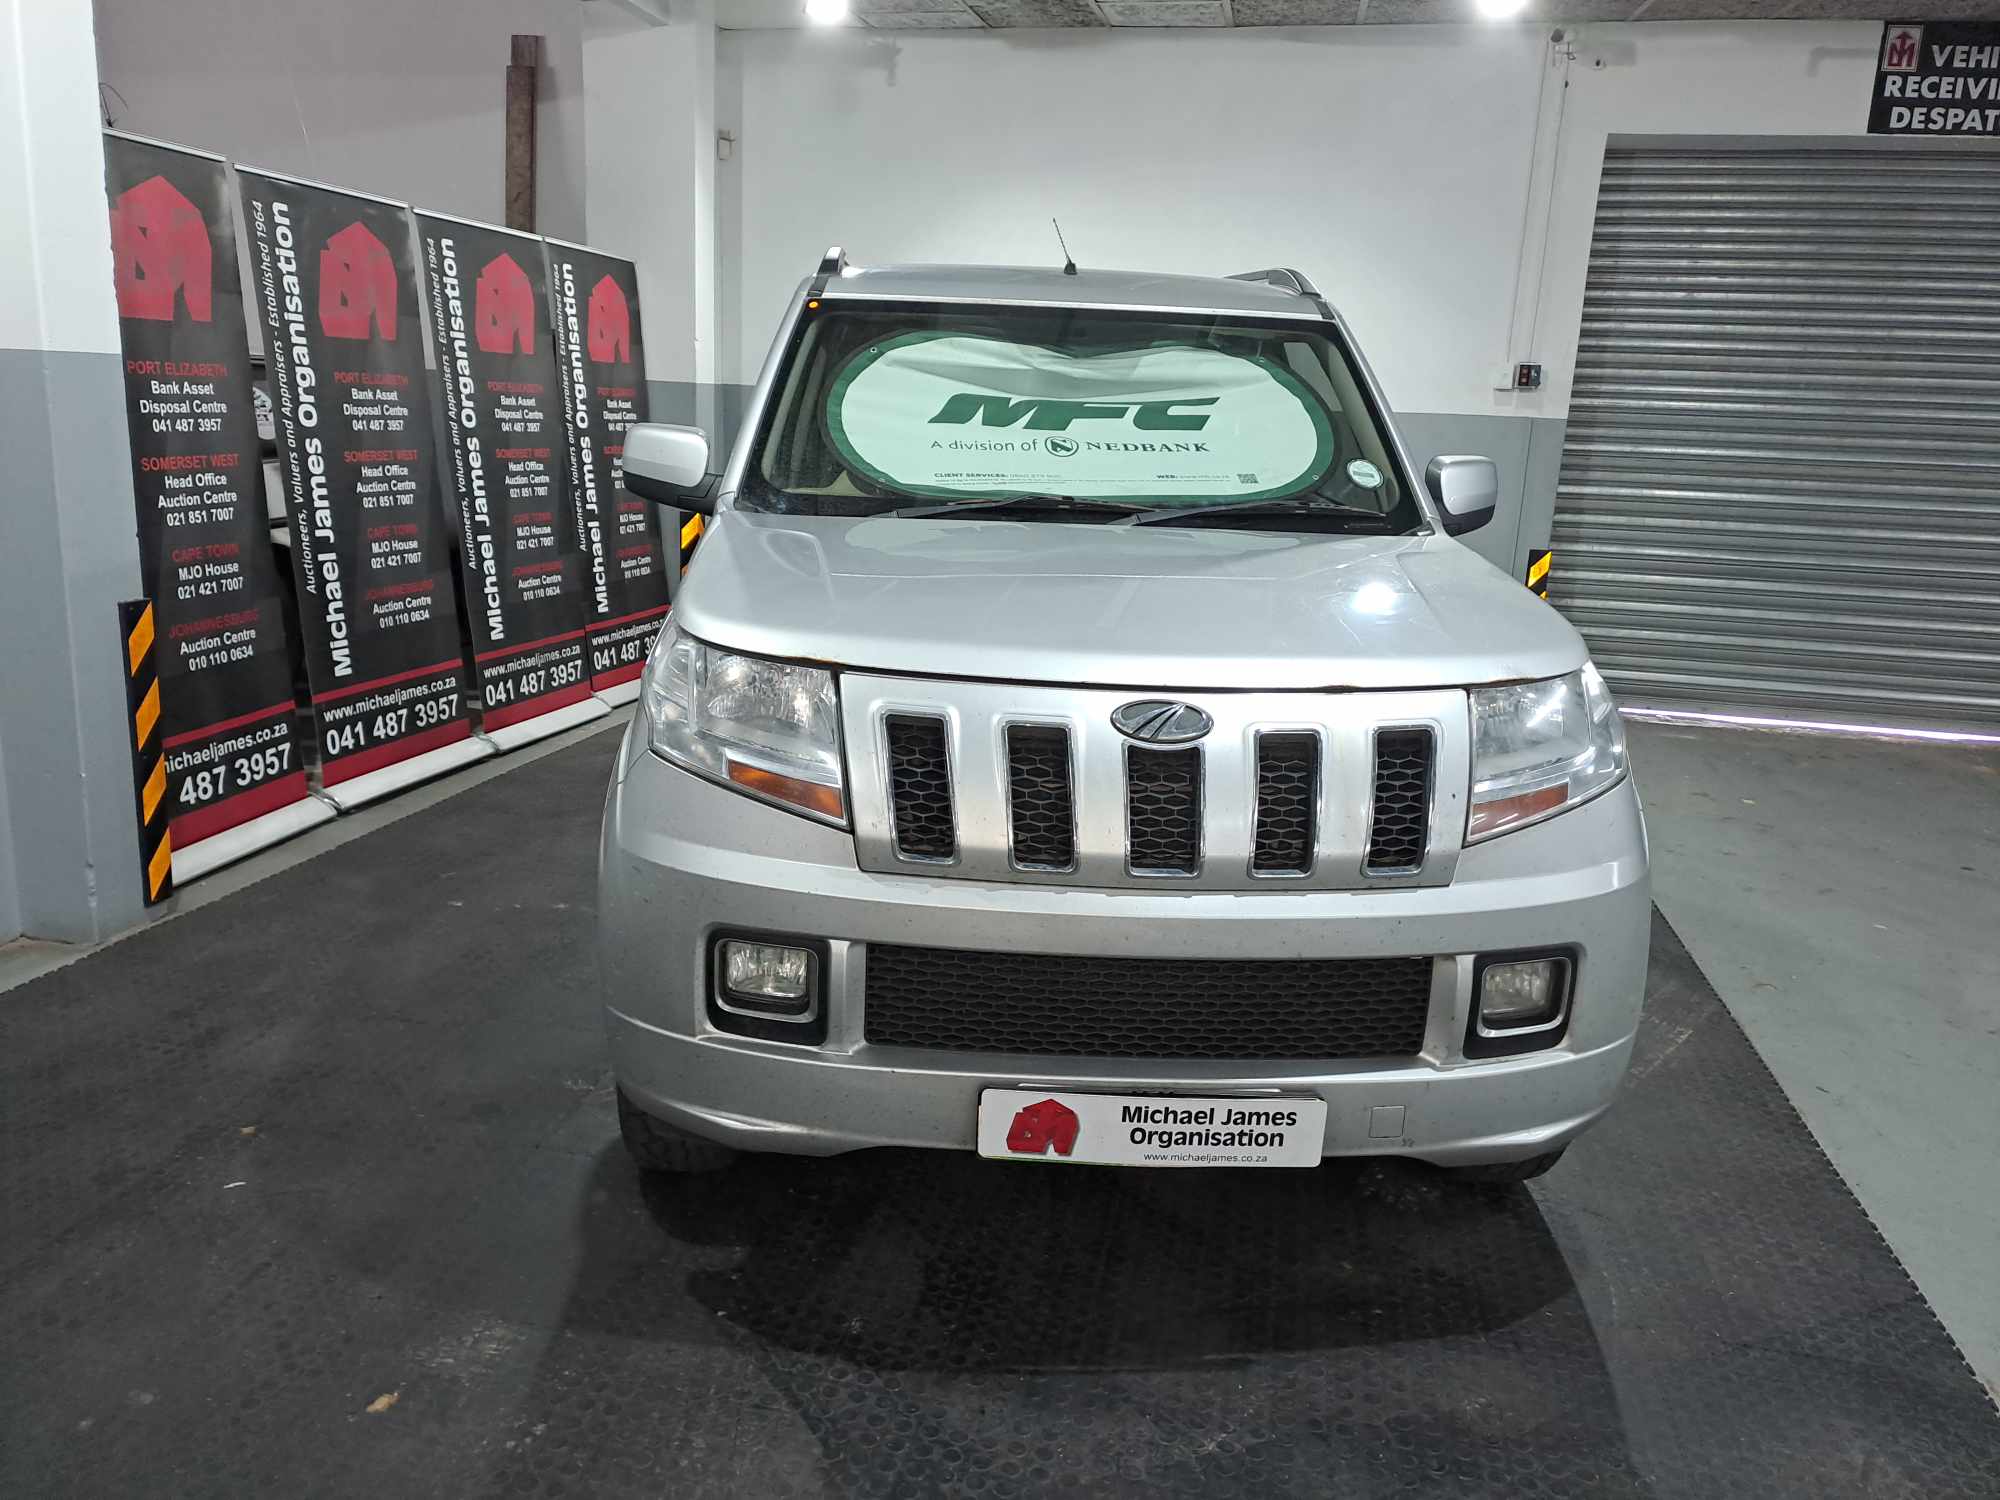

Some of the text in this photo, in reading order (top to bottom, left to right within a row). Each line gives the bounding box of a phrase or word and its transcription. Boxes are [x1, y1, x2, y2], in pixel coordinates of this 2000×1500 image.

[1931, 44, 2000, 69] VEHI
[1883, 74, 2000, 100] RECEIVI
[252, 199, 268, 238] 1964
[257, 241, 280, 328] Established
[127, 359, 162, 375] PORT
[273, 340, 293, 417] Appraisers
[151, 380, 214, 395] Bank Asset
[351, 388, 398, 401] Bank Asset
[139, 400, 228, 415] Disposal Centre
[343, 403, 408, 418] Disposal Centre
[927, 392, 1221, 431] MFC
[152, 418, 222, 432] 041 487 3957
[282, 419, 297, 448] and
[352, 420, 368, 431] 041
[369, 420, 384, 431] 487
[449, 420, 461, 446] and
[272, 201, 353, 678] Michael James Organisation
[440, 238, 505, 641] Michael James Organisation
[562, 263, 609, 614] Michael James Organisation
[931, 440, 943, 449] A
[948, 439, 1015, 452] division
[1020, 438, 1039, 452] of
[1086, 441, 1210, 453] NEDBANK
[140, 453, 240, 472] SOMERSET WEST
[361, 465, 408, 477] Head Office
[455, 448, 466, 493] Valuers
[165, 472, 227, 489] Head Office
[288, 451, 304, 503] Valuers
[356, 480, 416, 493] Auction Centre
[158, 490, 238, 509] Auction Centre
[362, 497, 377, 508] 021
[396, 494, 414, 506] 7007
[166, 507, 235, 527] 021 851 7007
[298, 508, 318, 594] Auctioneers,
[392, 539, 418, 551] House
[178, 562, 239, 582] MJO House
[371, 552, 422, 569] 021 421 7007
[177, 576, 244, 600] 021 421 7007
[372, 600, 404, 615] Auction
[379, 616, 394, 629] 010
[395, 613, 409, 625] 110
[180, 628, 257, 656] Auction Centre
[188, 644, 254, 672] 010 110 0634
[483, 644, 581, 679] www.michaeljames.co.za
[593, 647, 617, 671] 041
[620, 639, 640, 662] 487
[485, 659, 582, 706] 041 487 3957
[323, 676, 456, 723] www.michaeljames.co.za
[326, 693, 458, 755] 041 487 3957
[179, 741, 291, 805] 487 3957
[1121, 1105, 1297, 1127] Michael James
[1129, 1127, 1285, 1151] Organisation
